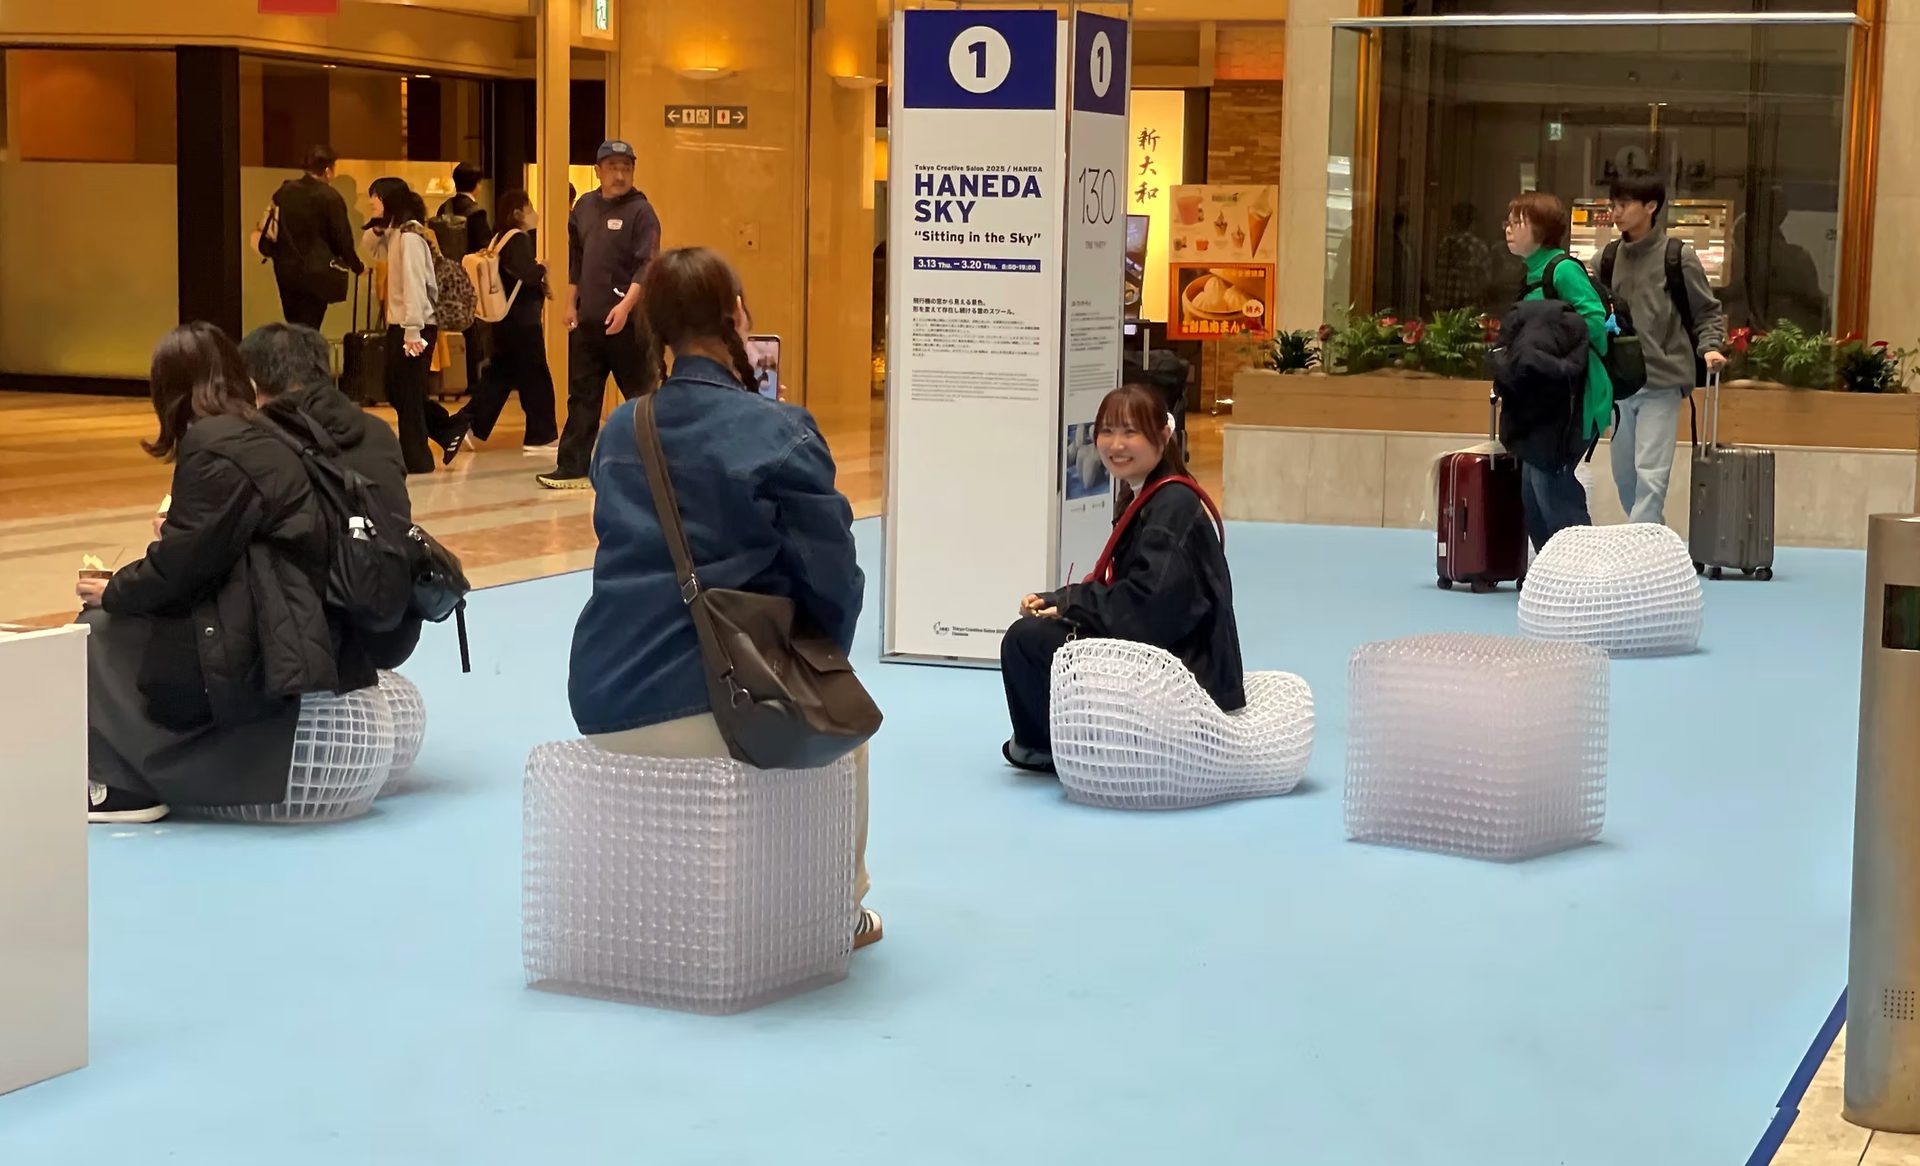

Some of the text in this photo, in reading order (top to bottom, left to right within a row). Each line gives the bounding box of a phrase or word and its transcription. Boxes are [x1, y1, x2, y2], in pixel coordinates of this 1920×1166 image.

[968, 41, 987, 78] 1
[1097, 46, 1104, 83] 1
[1134, 127, 1161, 204] 新大和
[915, 173, 1042, 198] HANEDA
[1078, 167, 1116, 225] 130
[914, 199, 976, 223] SKY
[969, 231, 980, 242] in
[985, 232, 1005, 243] the
[918, 259, 936, 268] 3.13
[938, 261, 952, 269] Thu.
[961, 260, 981, 269] 3.20
[983, 262, 998, 270] Thu.
